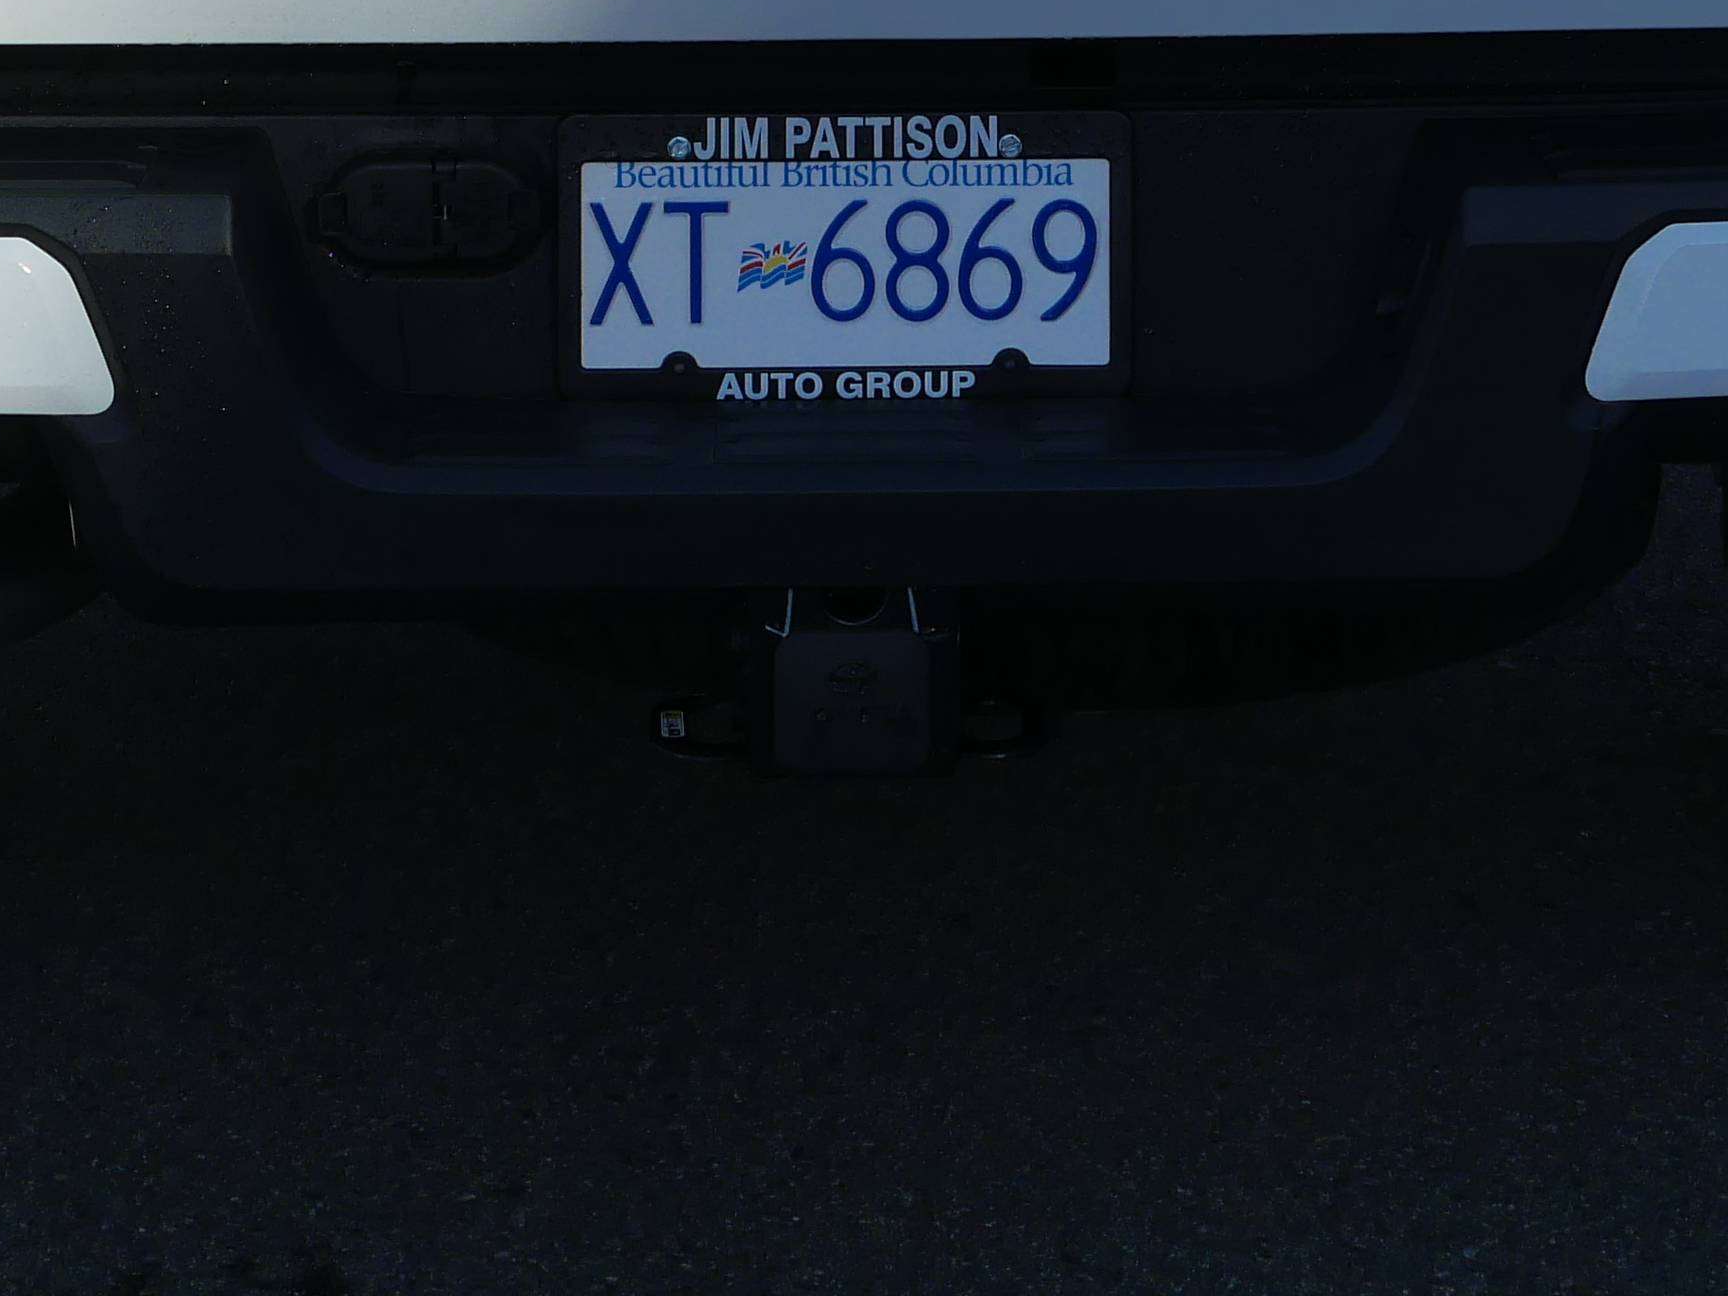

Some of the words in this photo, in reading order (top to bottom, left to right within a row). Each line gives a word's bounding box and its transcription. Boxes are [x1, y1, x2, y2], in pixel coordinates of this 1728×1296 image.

[693, 116, 769, 160] JIM
[785, 114, 998, 160] PATTISON
[615, 160, 769, 190] Beautiful
[781, 159, 893, 189] British
[901, 158, 1073, 188] Columbia
[589, 200, 731, 326] XT
[810, 197, 1099, 323] 6869
[716, 371, 824, 401] AUTO
[835, 369, 976, 400] GROUP
